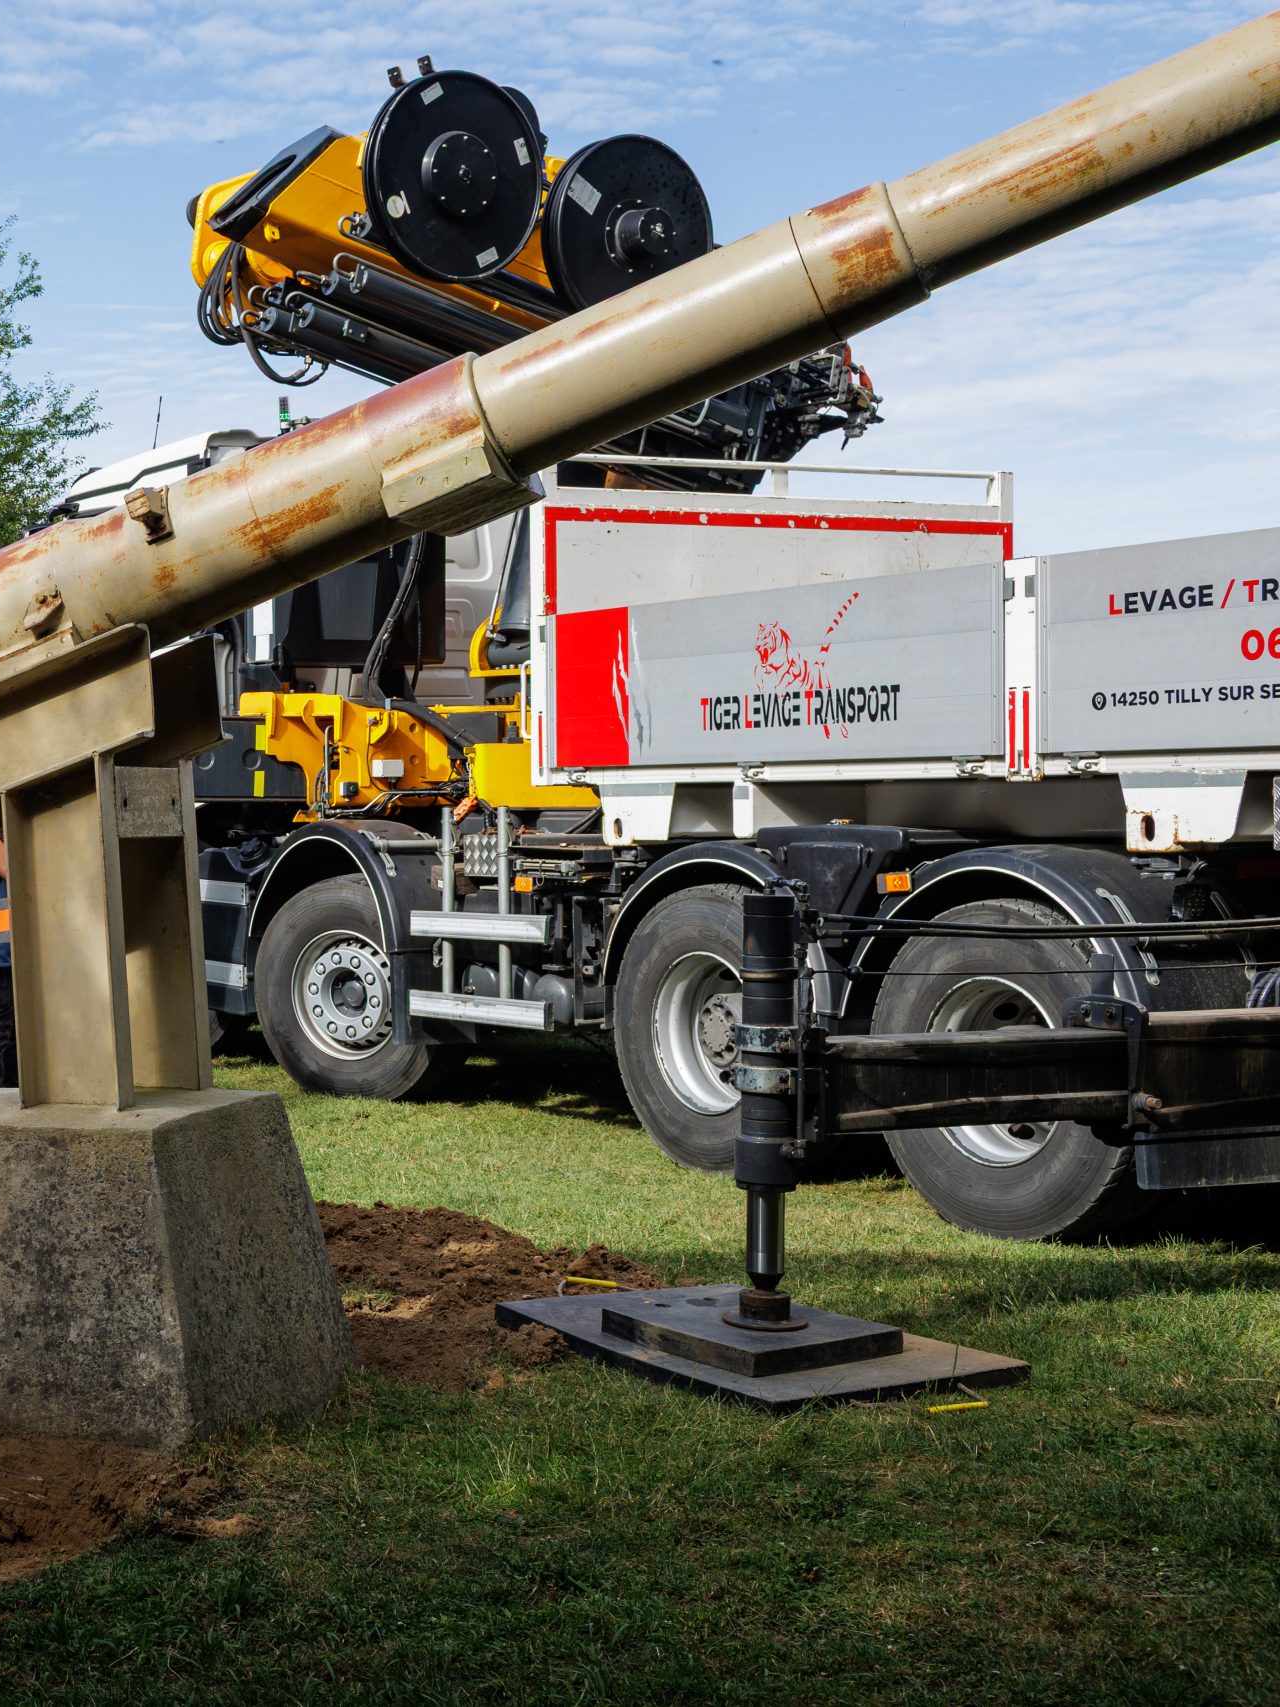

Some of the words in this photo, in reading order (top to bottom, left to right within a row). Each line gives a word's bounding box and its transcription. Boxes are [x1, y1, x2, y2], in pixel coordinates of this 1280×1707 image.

[1109, 584, 1214, 616] LEVAGE
[700, 695, 741, 731] TIGER
[744, 691, 801, 729] LEVAGE
[804, 684, 901, 726] TRANSPORT
[1110, 690, 1160, 707] 14250
[1164, 687, 1213, 704] TILLY
[1218, 685, 1255, 701] SUR
[1259, 683, 1280, 699] SE
